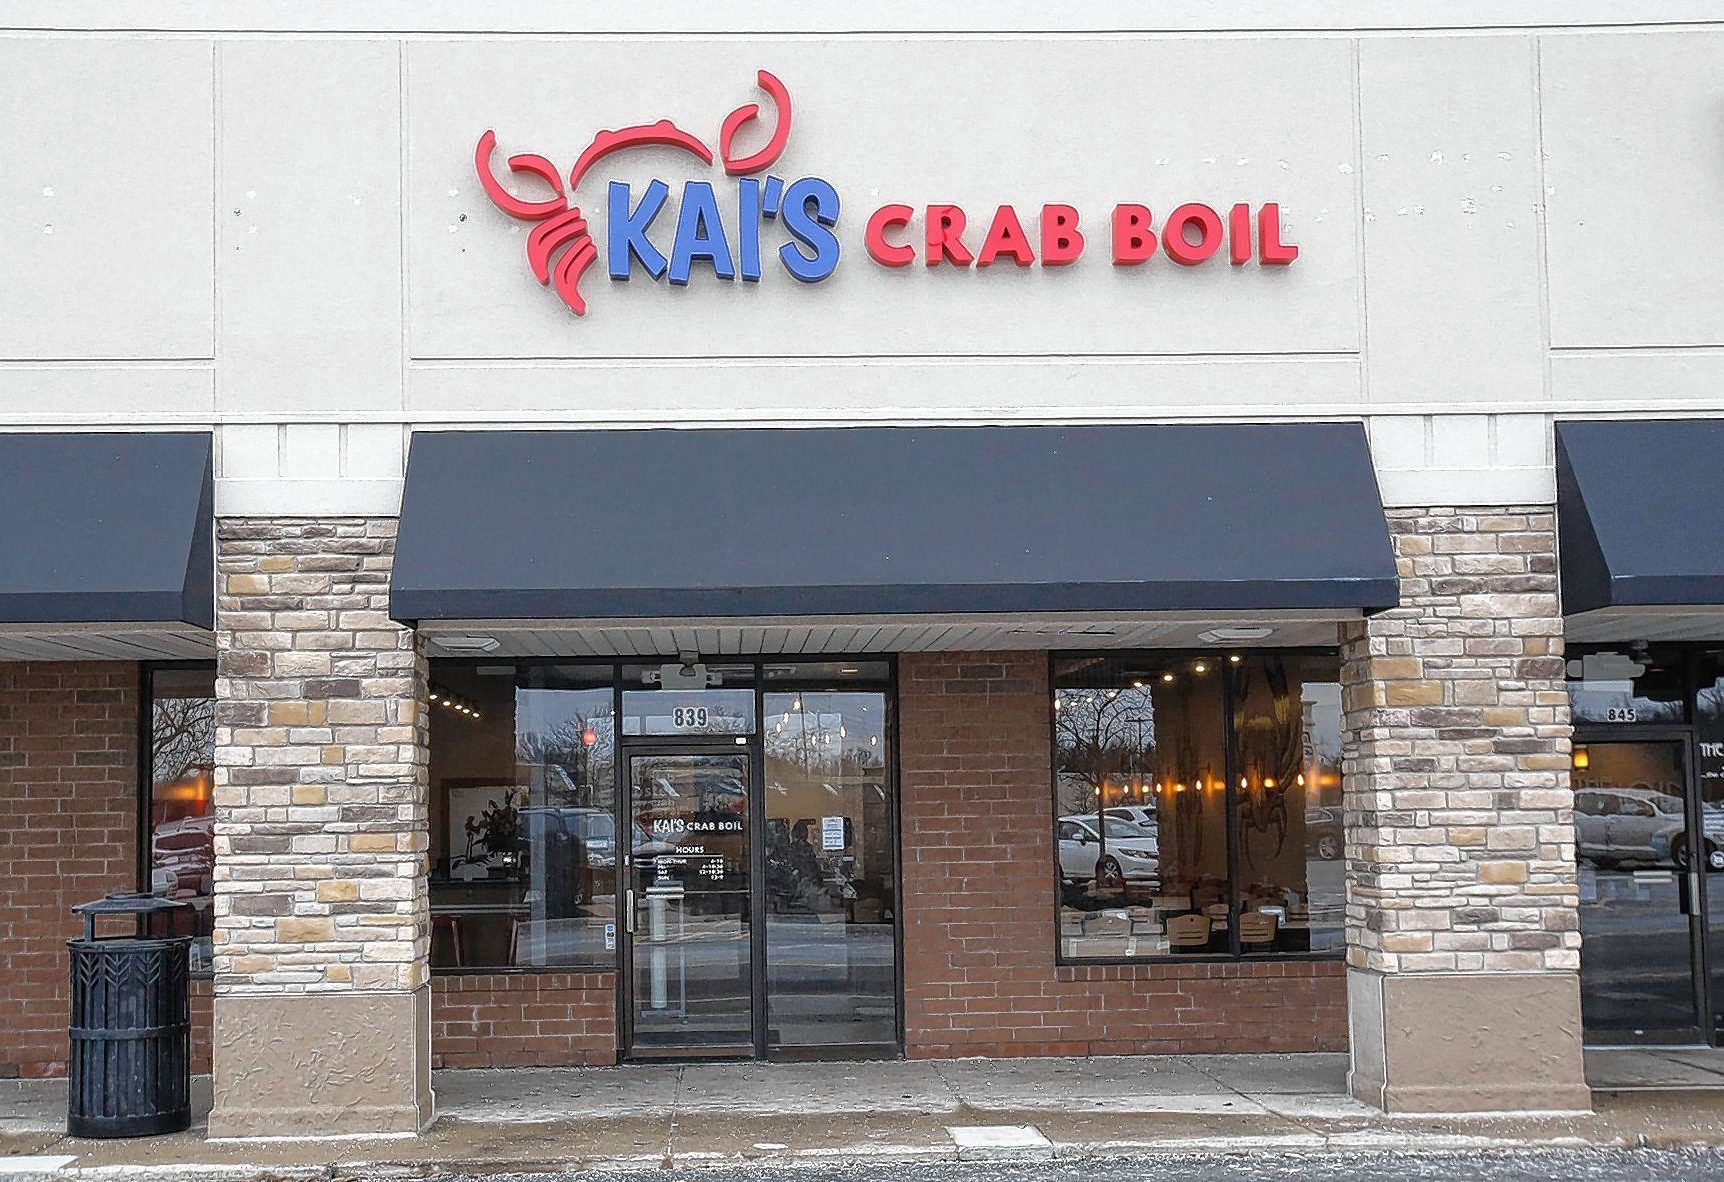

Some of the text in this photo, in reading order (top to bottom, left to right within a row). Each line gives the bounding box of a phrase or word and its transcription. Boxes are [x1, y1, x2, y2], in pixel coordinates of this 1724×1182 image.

[608, 176, 1298, 285] KAI'S CRAB BOIL
[672, 706, 709, 728] 839
[1608, 708, 1636, 722] 845
[653, 819, 743, 833] KAI'S CRAB BOIL
